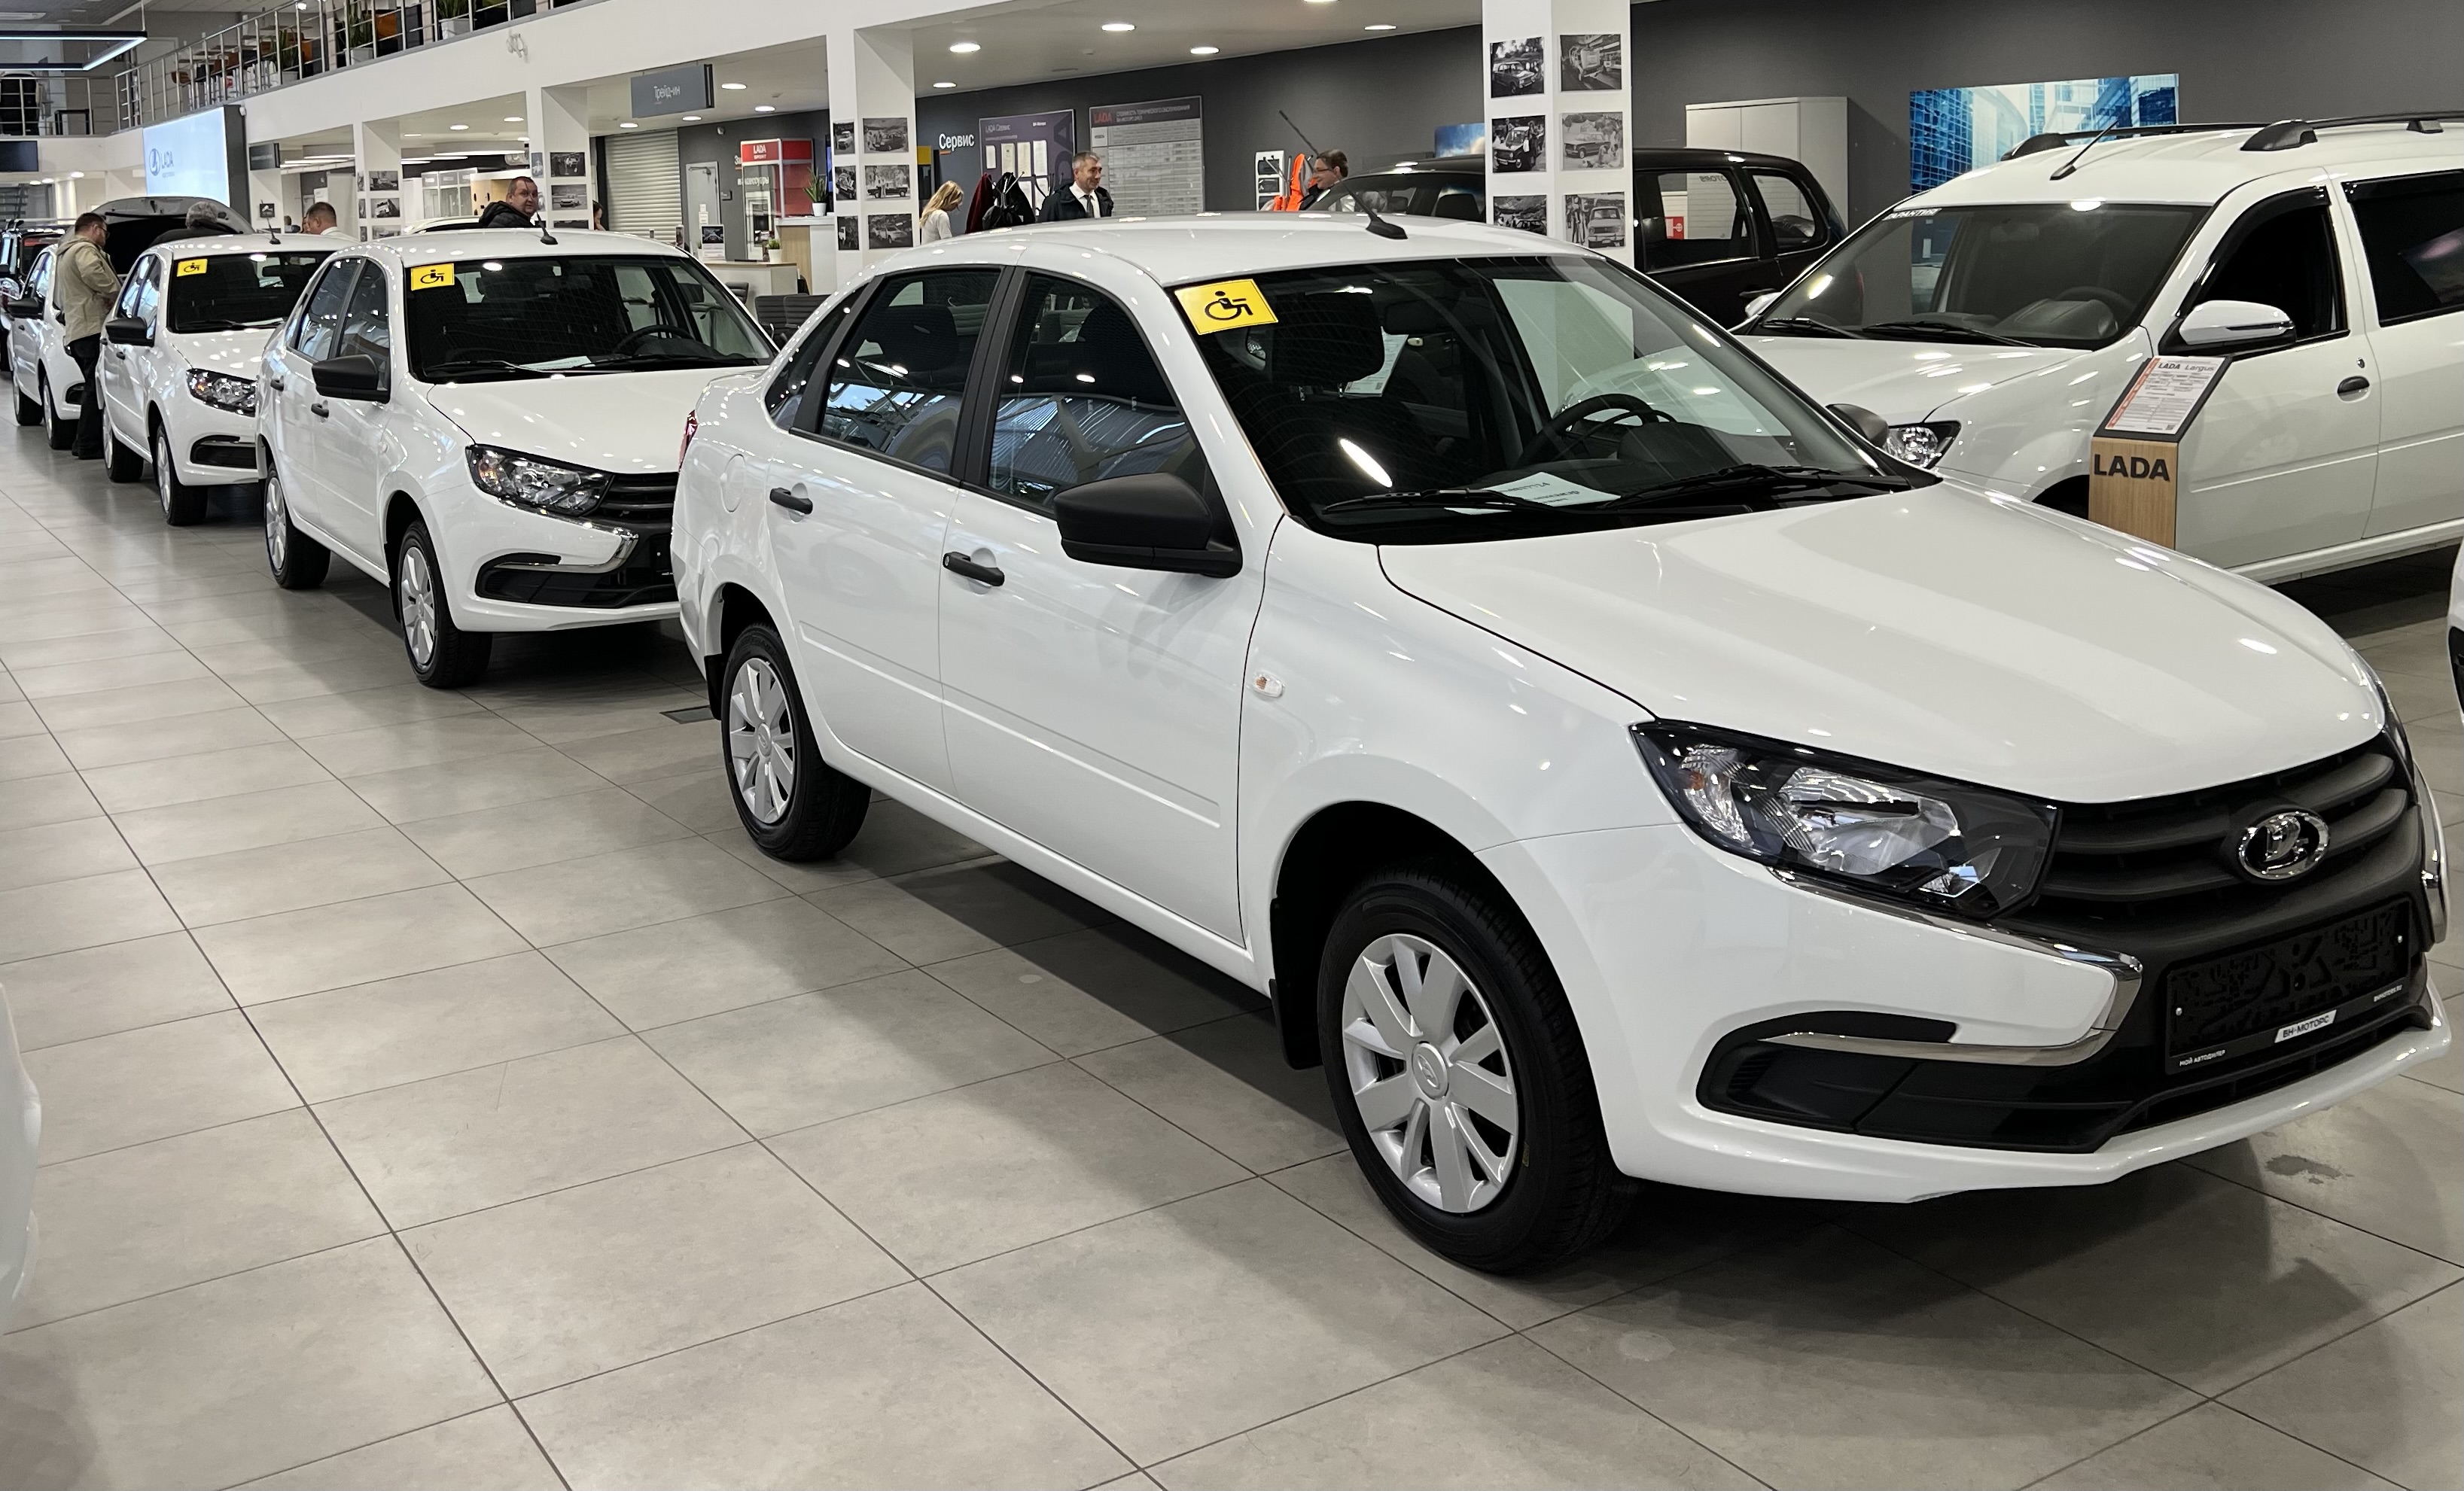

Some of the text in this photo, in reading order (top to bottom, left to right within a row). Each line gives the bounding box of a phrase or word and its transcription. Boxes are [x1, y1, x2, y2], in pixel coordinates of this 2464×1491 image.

[1093, 111, 1113, 123] LADA
[754, 145, 767, 154] LADA
[939, 133, 975, 152] Сервис
[160, 151, 175, 169] LADA
[2184, 364, 2215, 373] Largus
[2094, 454, 2171, 482] LADA
[2179, 1049, 2226, 1067] МОЙ АВТОДИЛЕР
